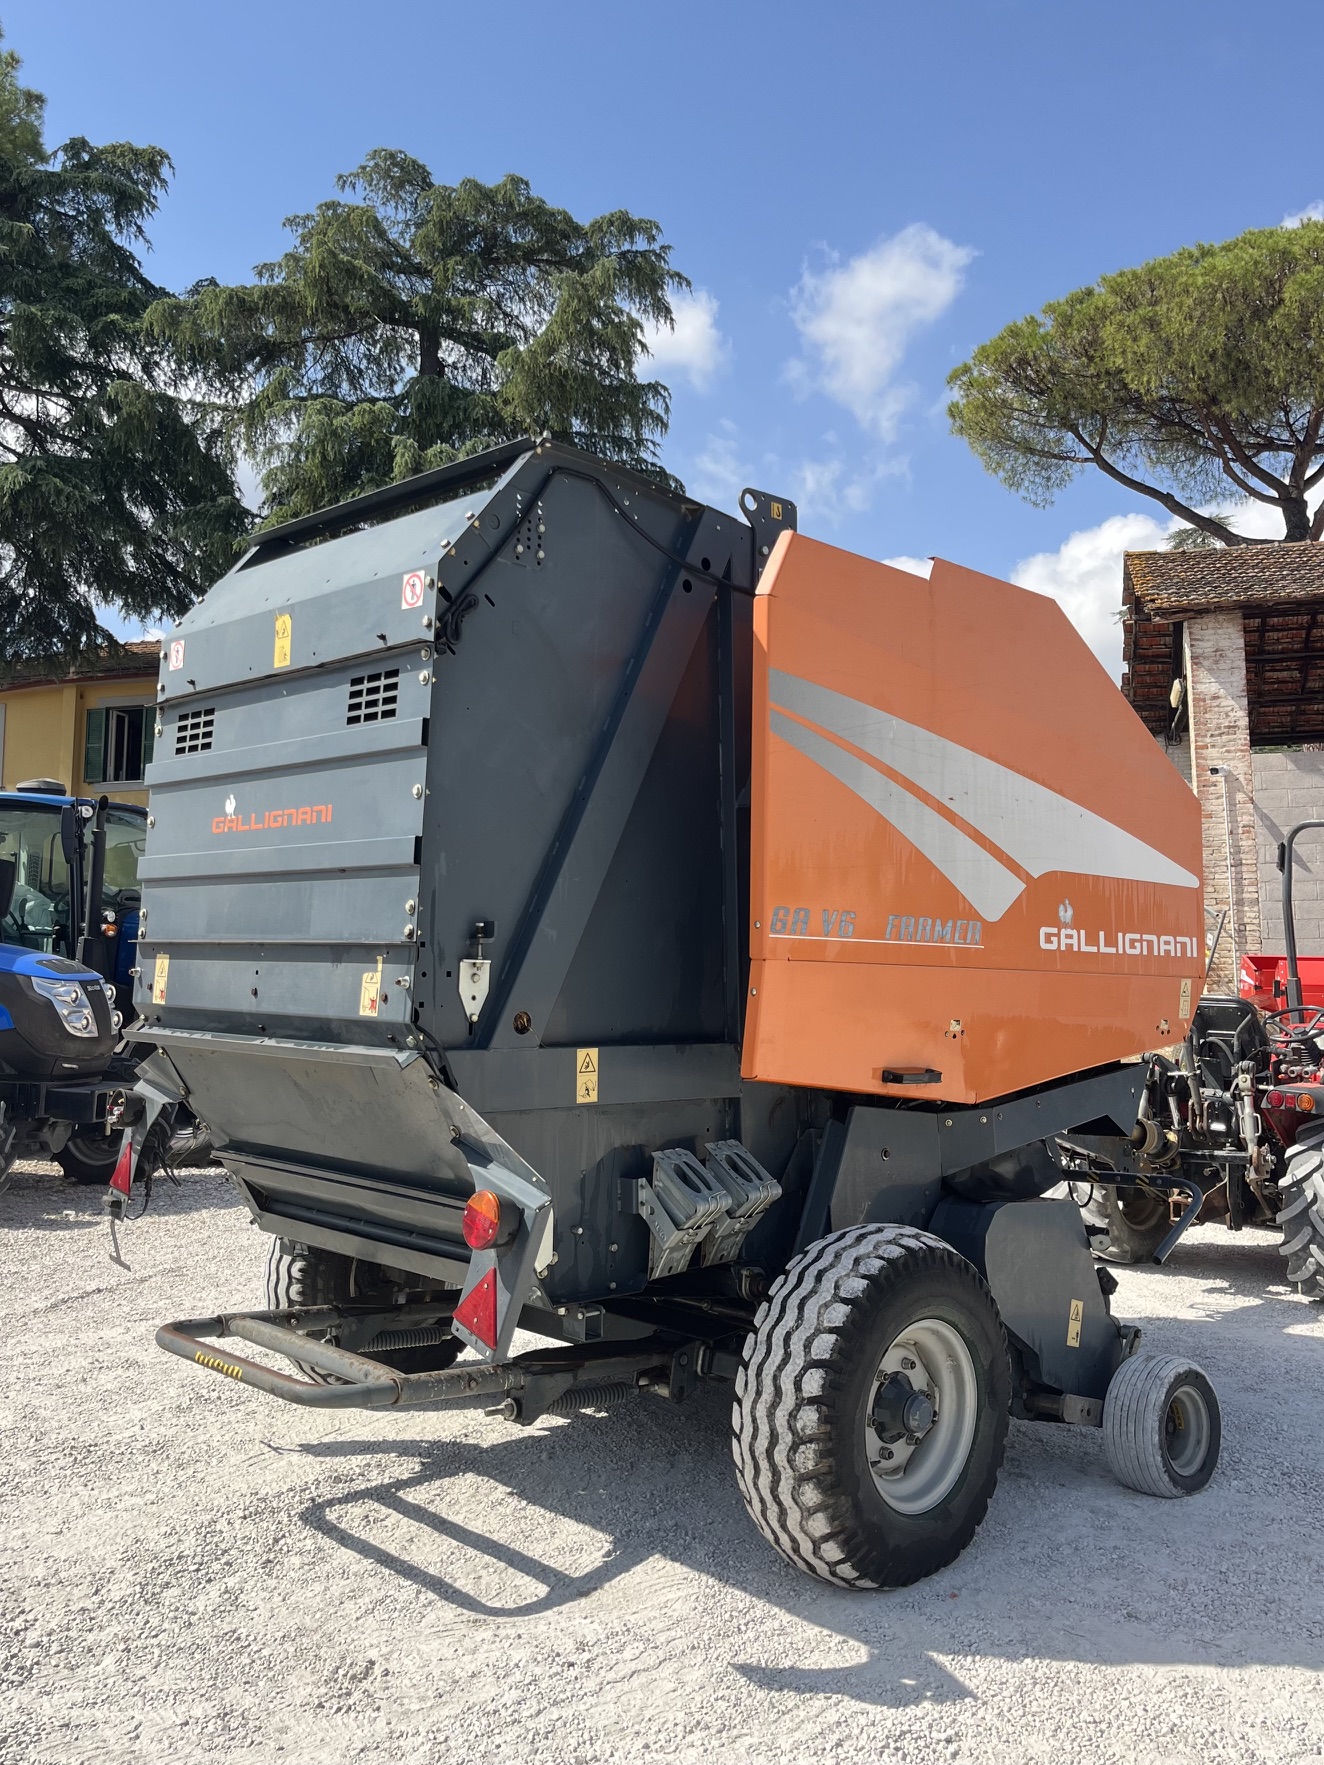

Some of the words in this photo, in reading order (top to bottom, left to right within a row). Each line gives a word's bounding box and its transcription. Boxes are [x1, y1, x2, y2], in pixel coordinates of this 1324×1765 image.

[212, 804, 332, 834] GALLIGNANI
[769, 905, 811, 935] GA
[821, 908, 857, 938] V6
[885, 914, 982, 945] FARMER
[1039, 926, 1198, 958] GALLIGNANI
